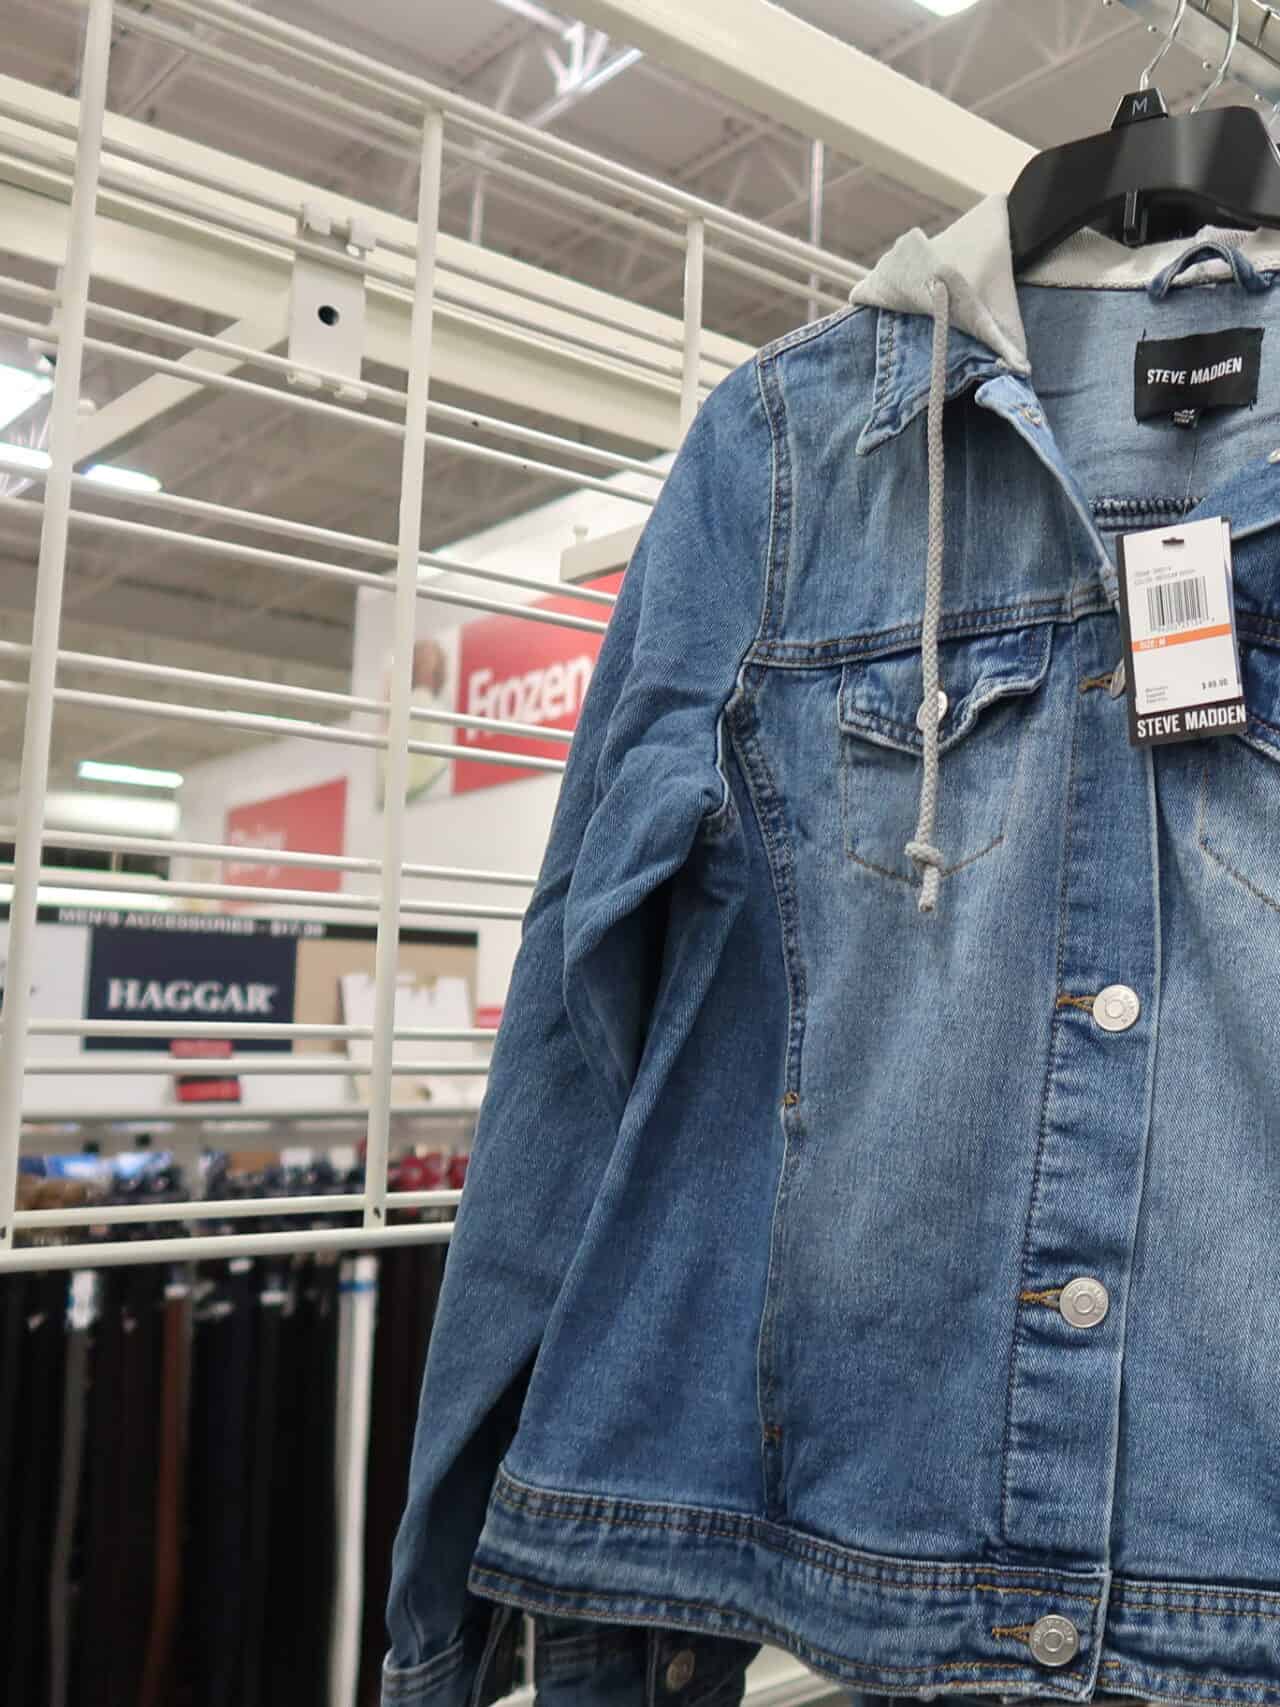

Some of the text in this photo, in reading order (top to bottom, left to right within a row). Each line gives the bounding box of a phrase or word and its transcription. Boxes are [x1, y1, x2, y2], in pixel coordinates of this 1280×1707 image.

[1131, 96, 1149, 114] M
[1146, 357, 1243, 385] STEVE MADDEN
[466, 655, 593, 741] Frozen
[1136, 703, 1247, 738] STEVE MADDEN
[107, 978, 273, 1013] HAGGAR
